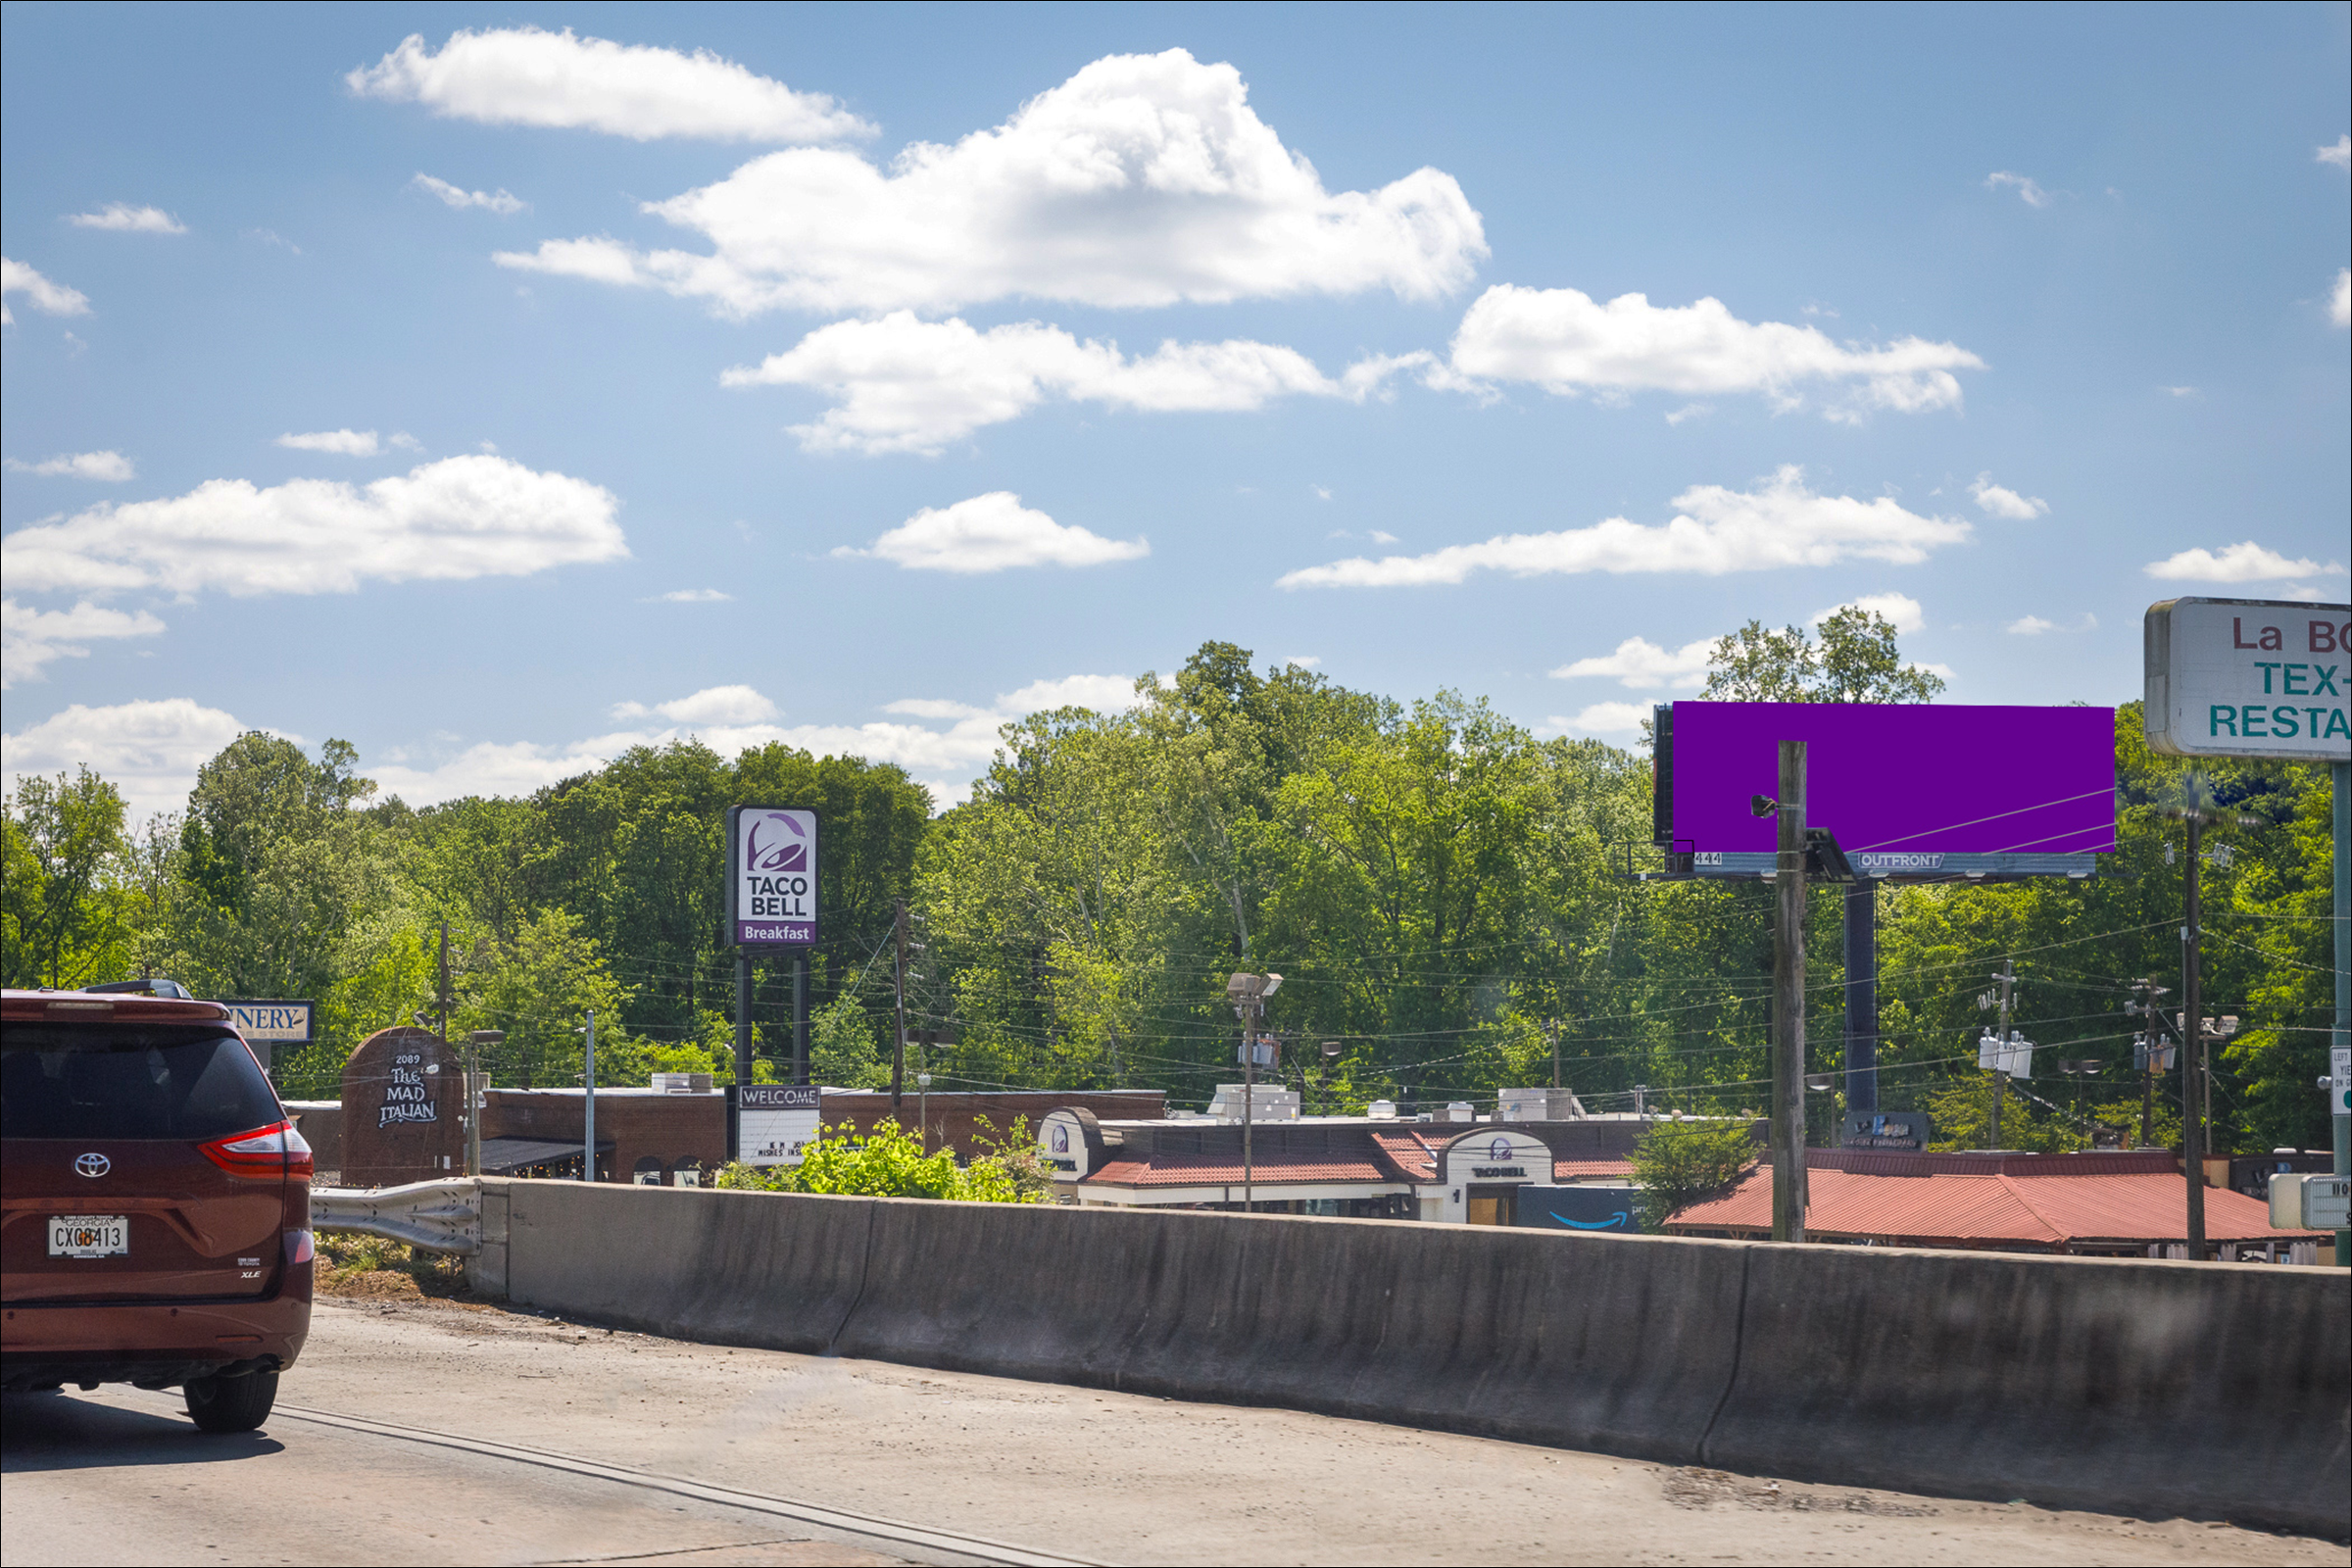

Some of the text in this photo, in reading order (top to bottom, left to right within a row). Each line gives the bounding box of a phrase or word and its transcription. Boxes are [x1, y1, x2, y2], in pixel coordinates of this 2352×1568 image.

[2233, 616, 2282, 651] La
[2210, 705, 2351, 740] RESTA
[1862, 855, 1939, 866] OUTFRONT
[747, 876, 808, 897] TACO
[752, 897, 807, 916] BELL
[745, 926, 809, 940] Breakfast
[230, 1007, 299, 1029] NERY
[396, 1054, 420, 1064] 2089
[2333, 1053, 2348, 1061] LEFT
[391, 1066, 421, 1085] The
[386, 1087, 425, 1102] MAD
[743, 1090, 817, 1104] WELCOME
[379, 1101, 435, 1122] ITALIAN
[55, 1227, 121, 1248] CXG8413
[240, 1270, 262, 1279] XLE
